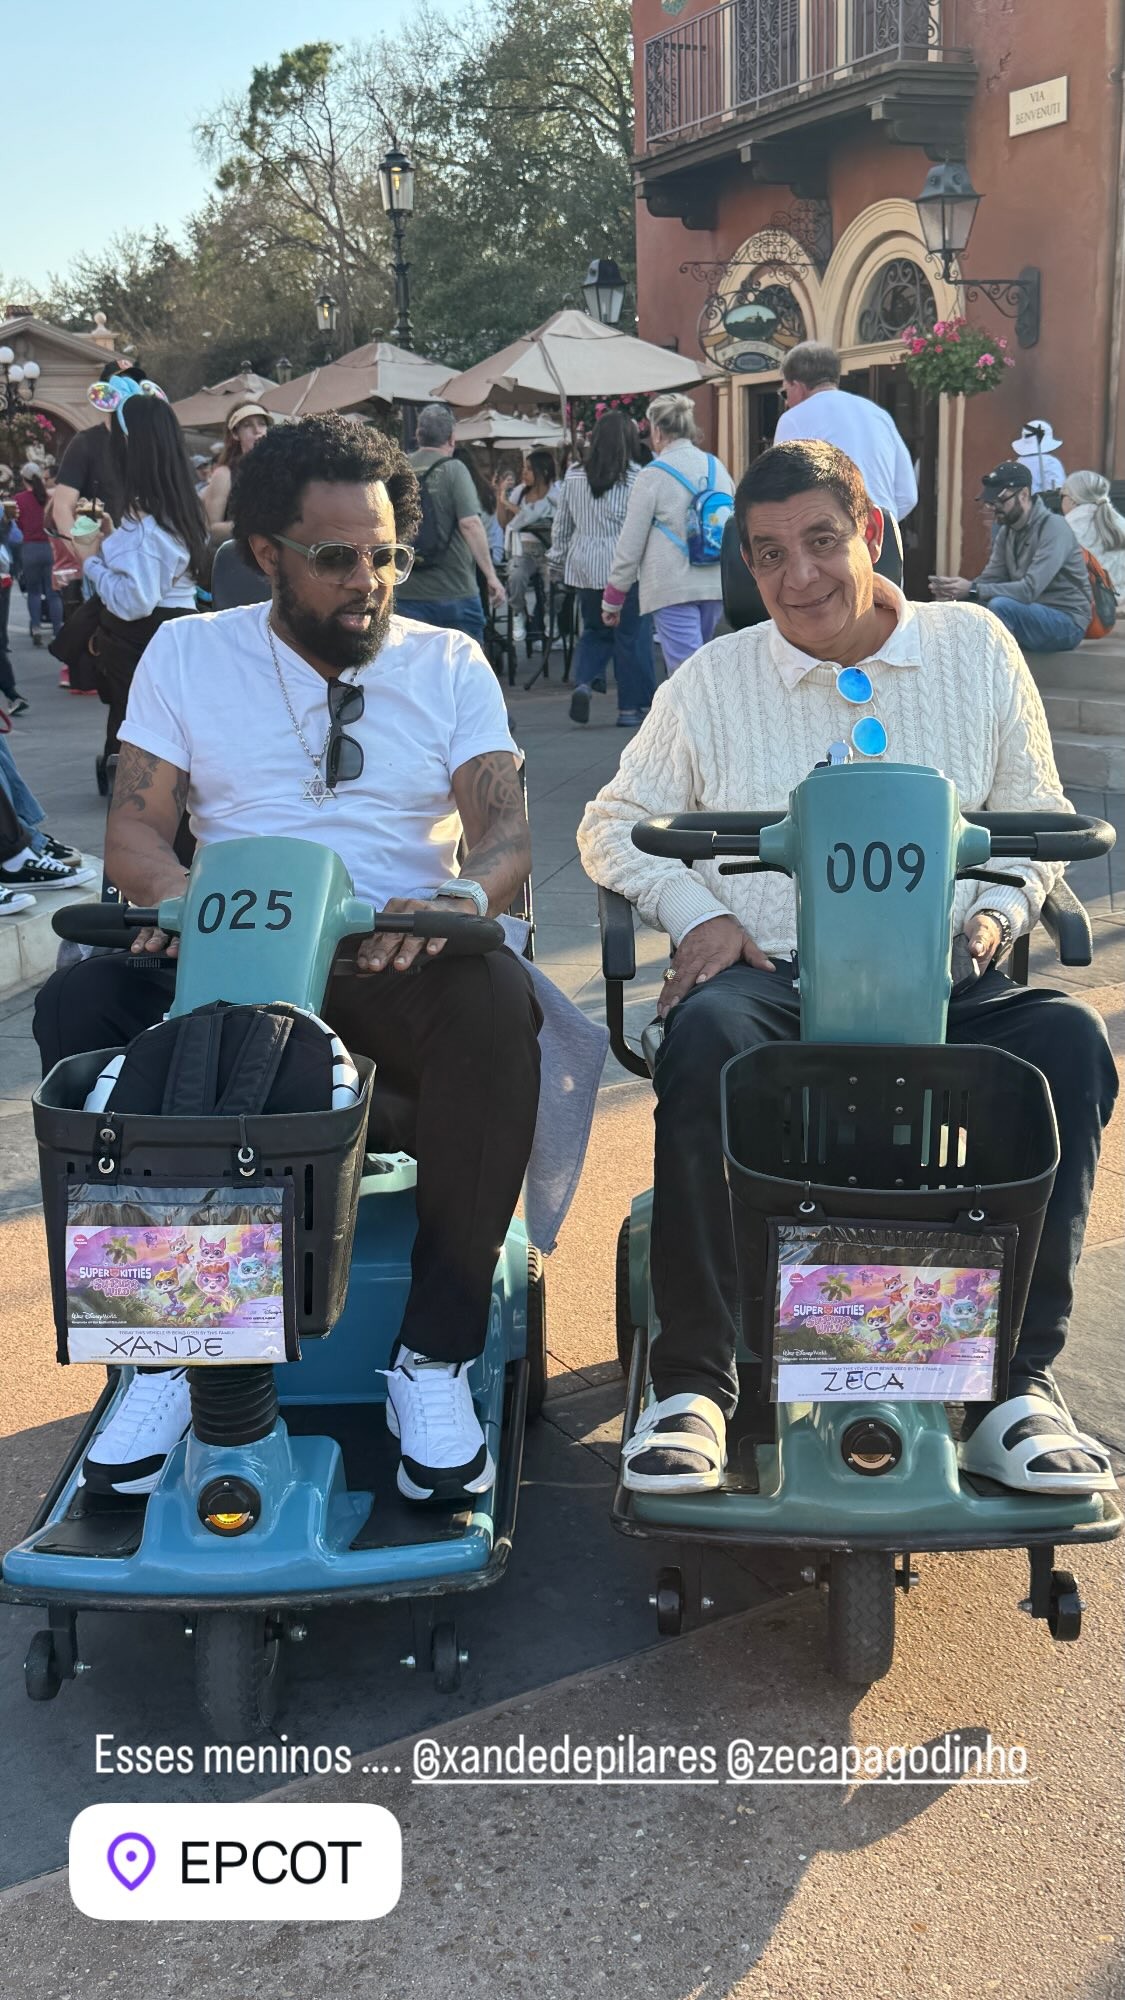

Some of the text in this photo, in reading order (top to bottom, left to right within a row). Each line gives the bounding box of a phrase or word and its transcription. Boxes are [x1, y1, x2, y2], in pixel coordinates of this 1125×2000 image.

[1030, 90, 1045, 102] VIA
[1015, 102, 1061, 126] BENVENUTI
[826, 841, 925, 894] 009
[197, 889, 293, 934] 025
[80, 1266, 152, 1279] SUPER KITTIES
[793, 1304, 865, 1316] SUPER KITTIES
[105, 1335, 224, 1358] XANDE
[820, 1370, 904, 1392] ZECA
